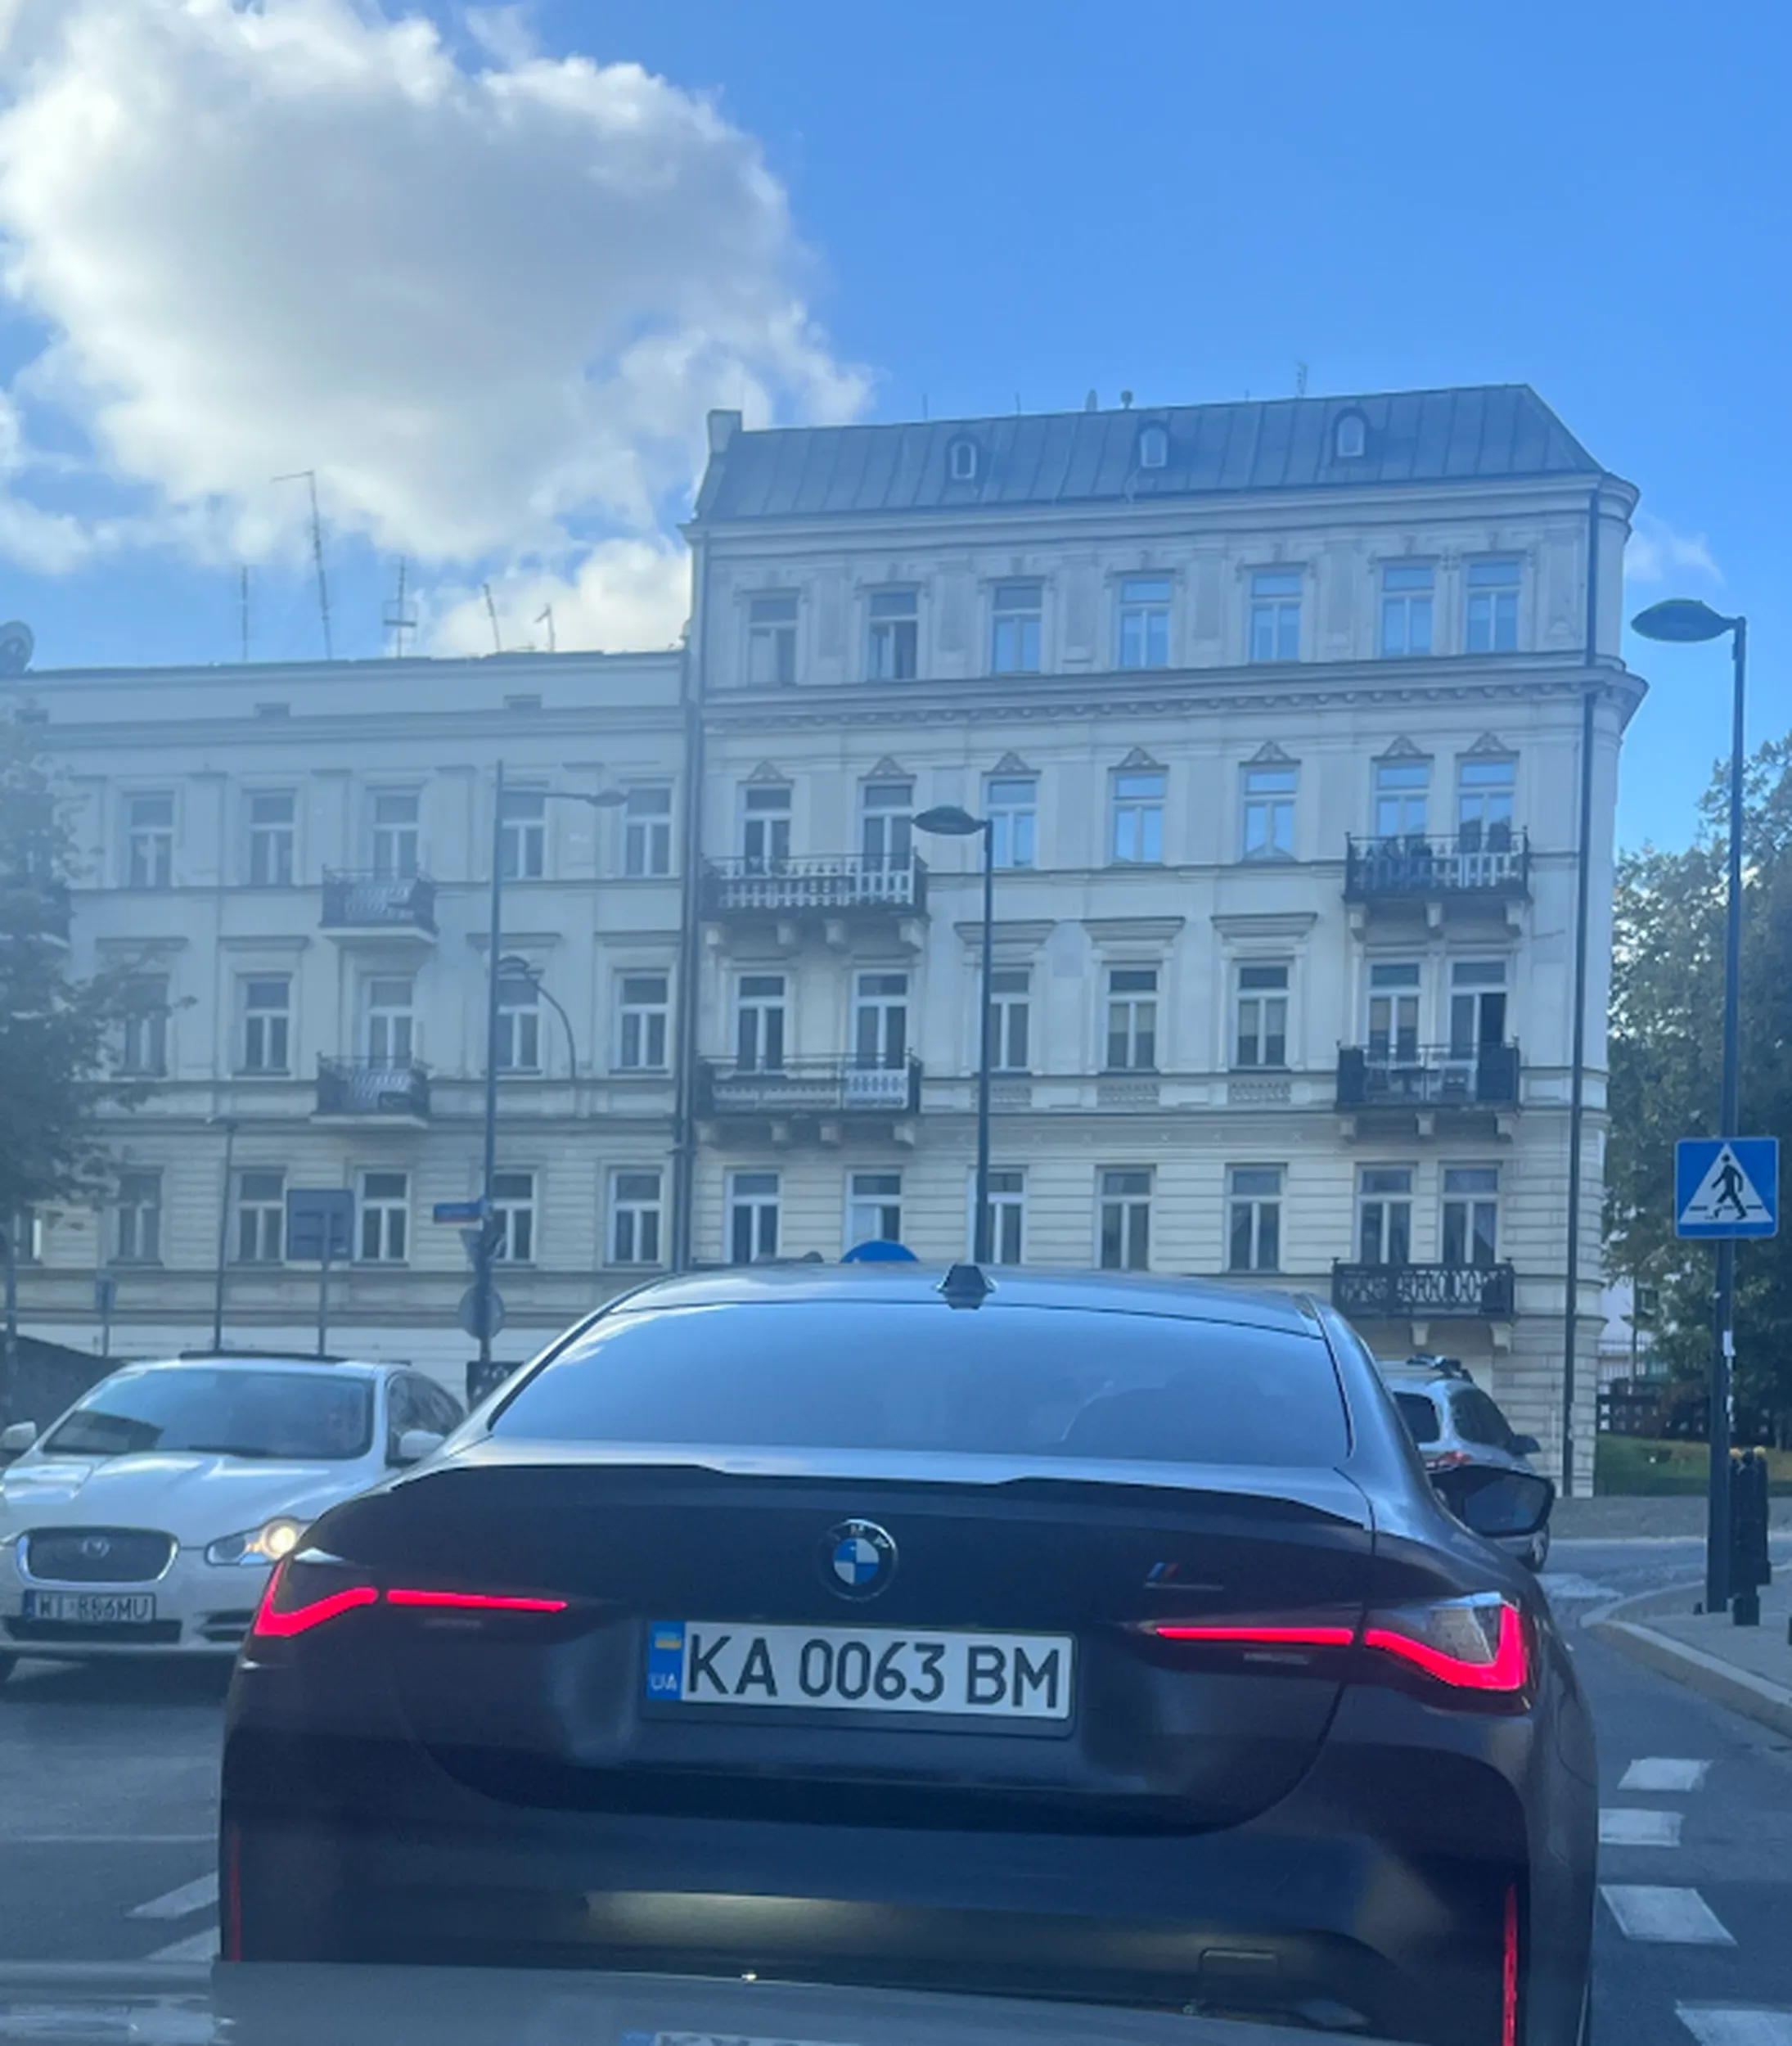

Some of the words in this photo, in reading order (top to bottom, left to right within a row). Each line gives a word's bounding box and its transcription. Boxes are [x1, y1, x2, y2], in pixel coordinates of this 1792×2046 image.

[651, 1673, 678, 1691] UA
[689, 1634, 778, 1697] KA
[799, 1639, 945, 1702] 0063
[966, 1645, 1060, 1708] BM
